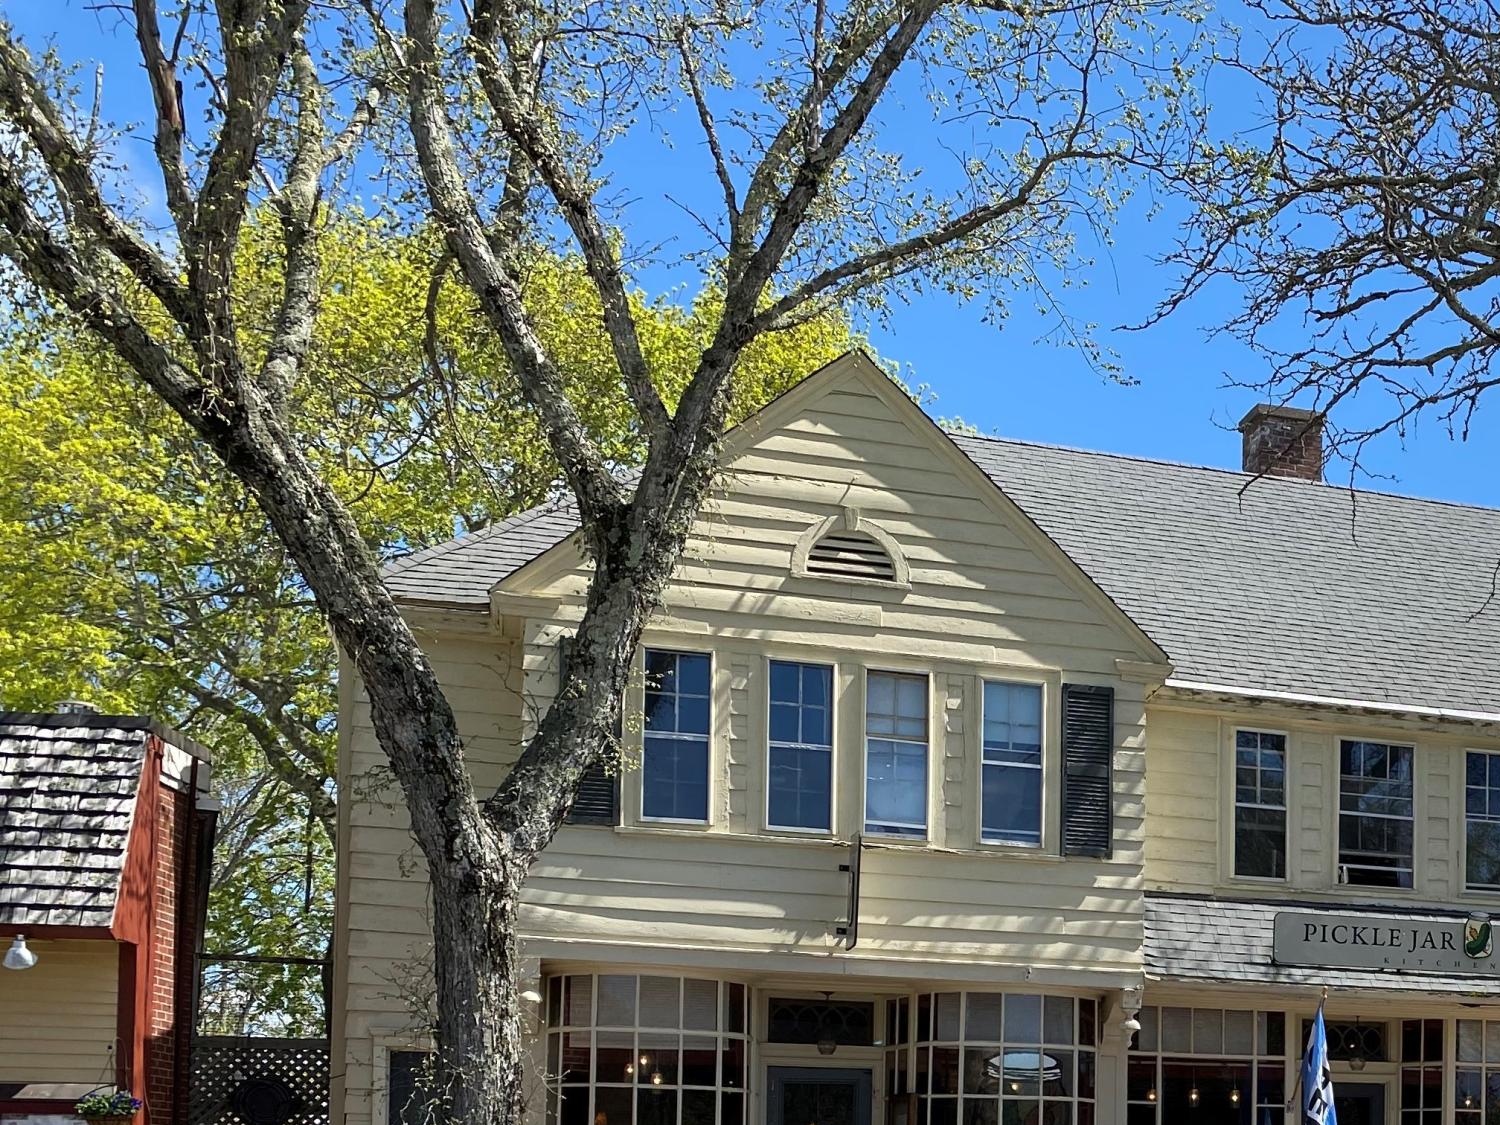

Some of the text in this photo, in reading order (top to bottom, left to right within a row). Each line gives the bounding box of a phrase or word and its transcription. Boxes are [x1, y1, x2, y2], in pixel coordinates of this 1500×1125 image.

[1303, 923, 1457, 953] PICKLE JAR
[1383, 957, 1497, 970] KITCHEN
